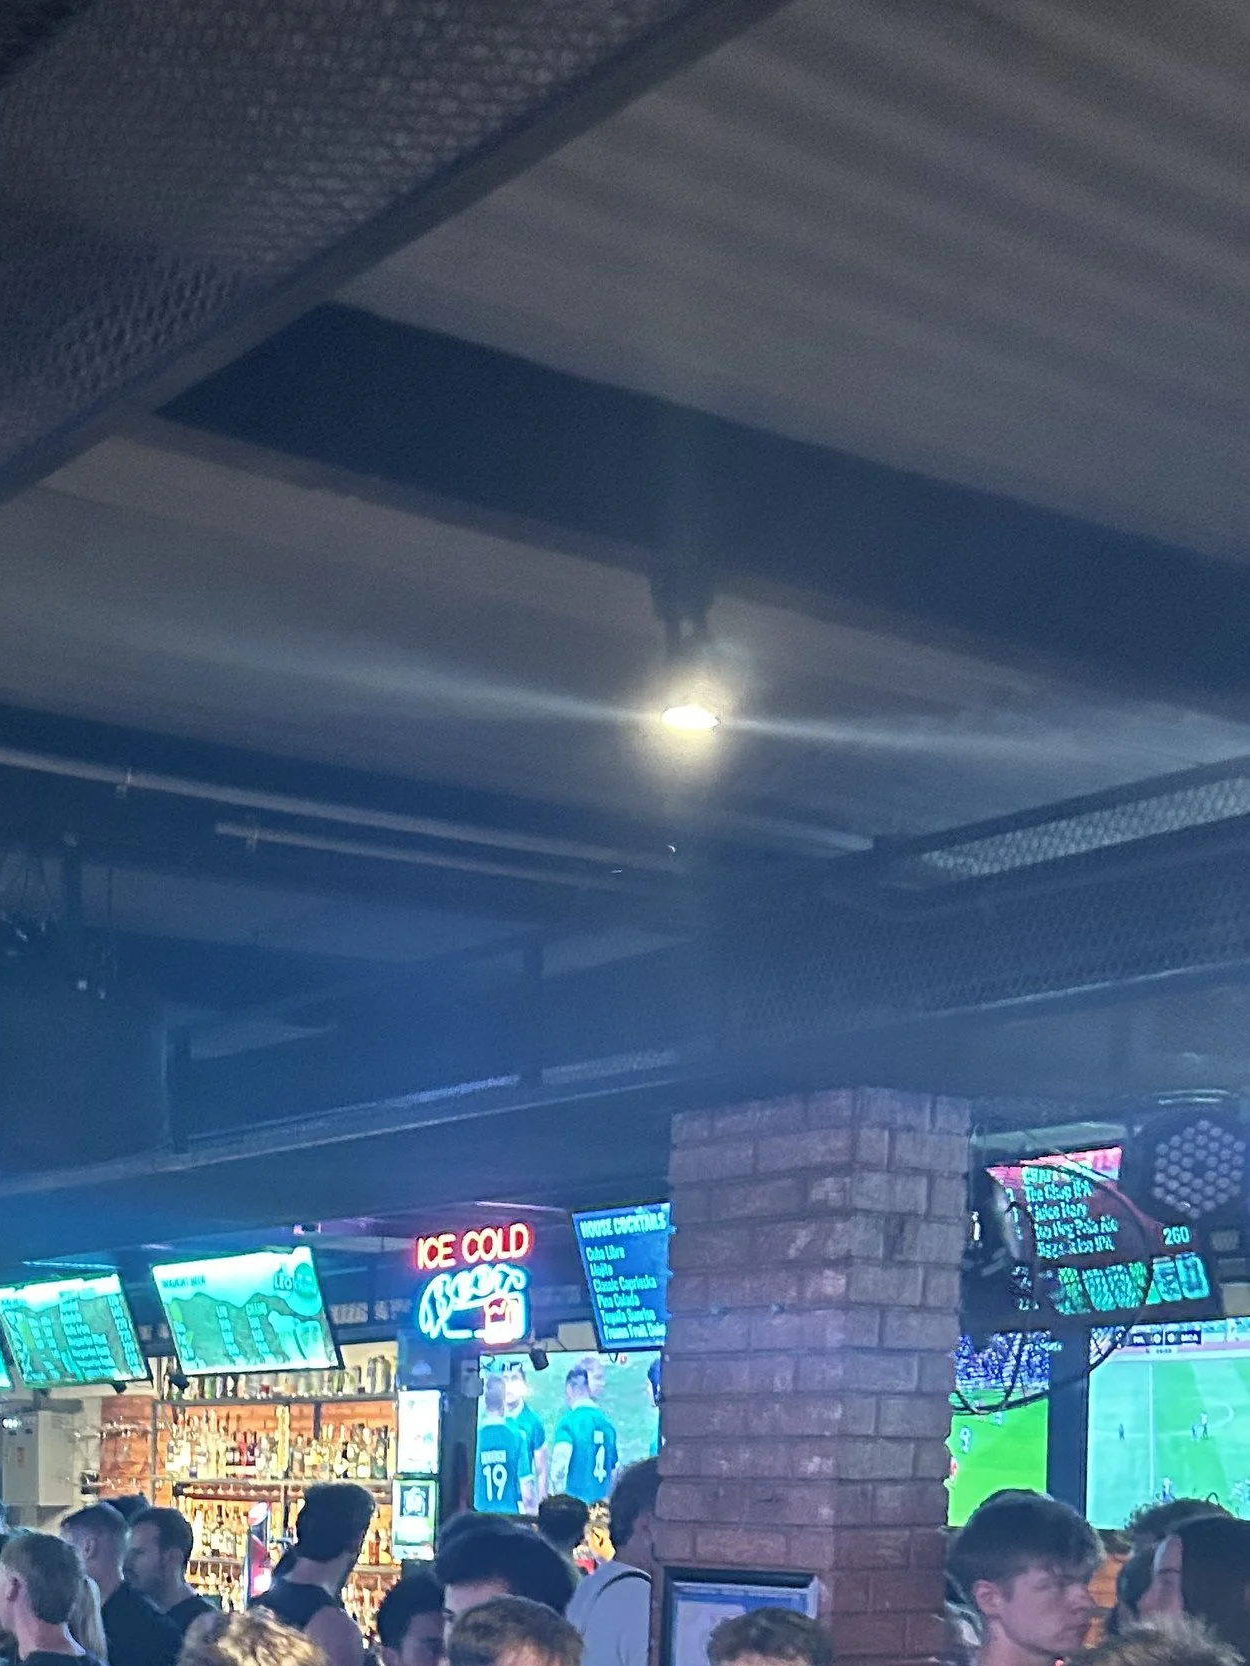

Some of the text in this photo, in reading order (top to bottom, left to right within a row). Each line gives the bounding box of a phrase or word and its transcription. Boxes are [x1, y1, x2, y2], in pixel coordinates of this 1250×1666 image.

[580, 1211, 668, 1239] HOUSE COCKTAILS
[1162, 1224, 1191, 1246] 260
[417, 1223, 529, 1270] ICE COLD
[586, 1246, 606, 1261] Cuba
[274, 1275, 293, 1291] LEO
[593, 1444, 607, 1484] 4
[482, 1463, 508, 1502] 19
